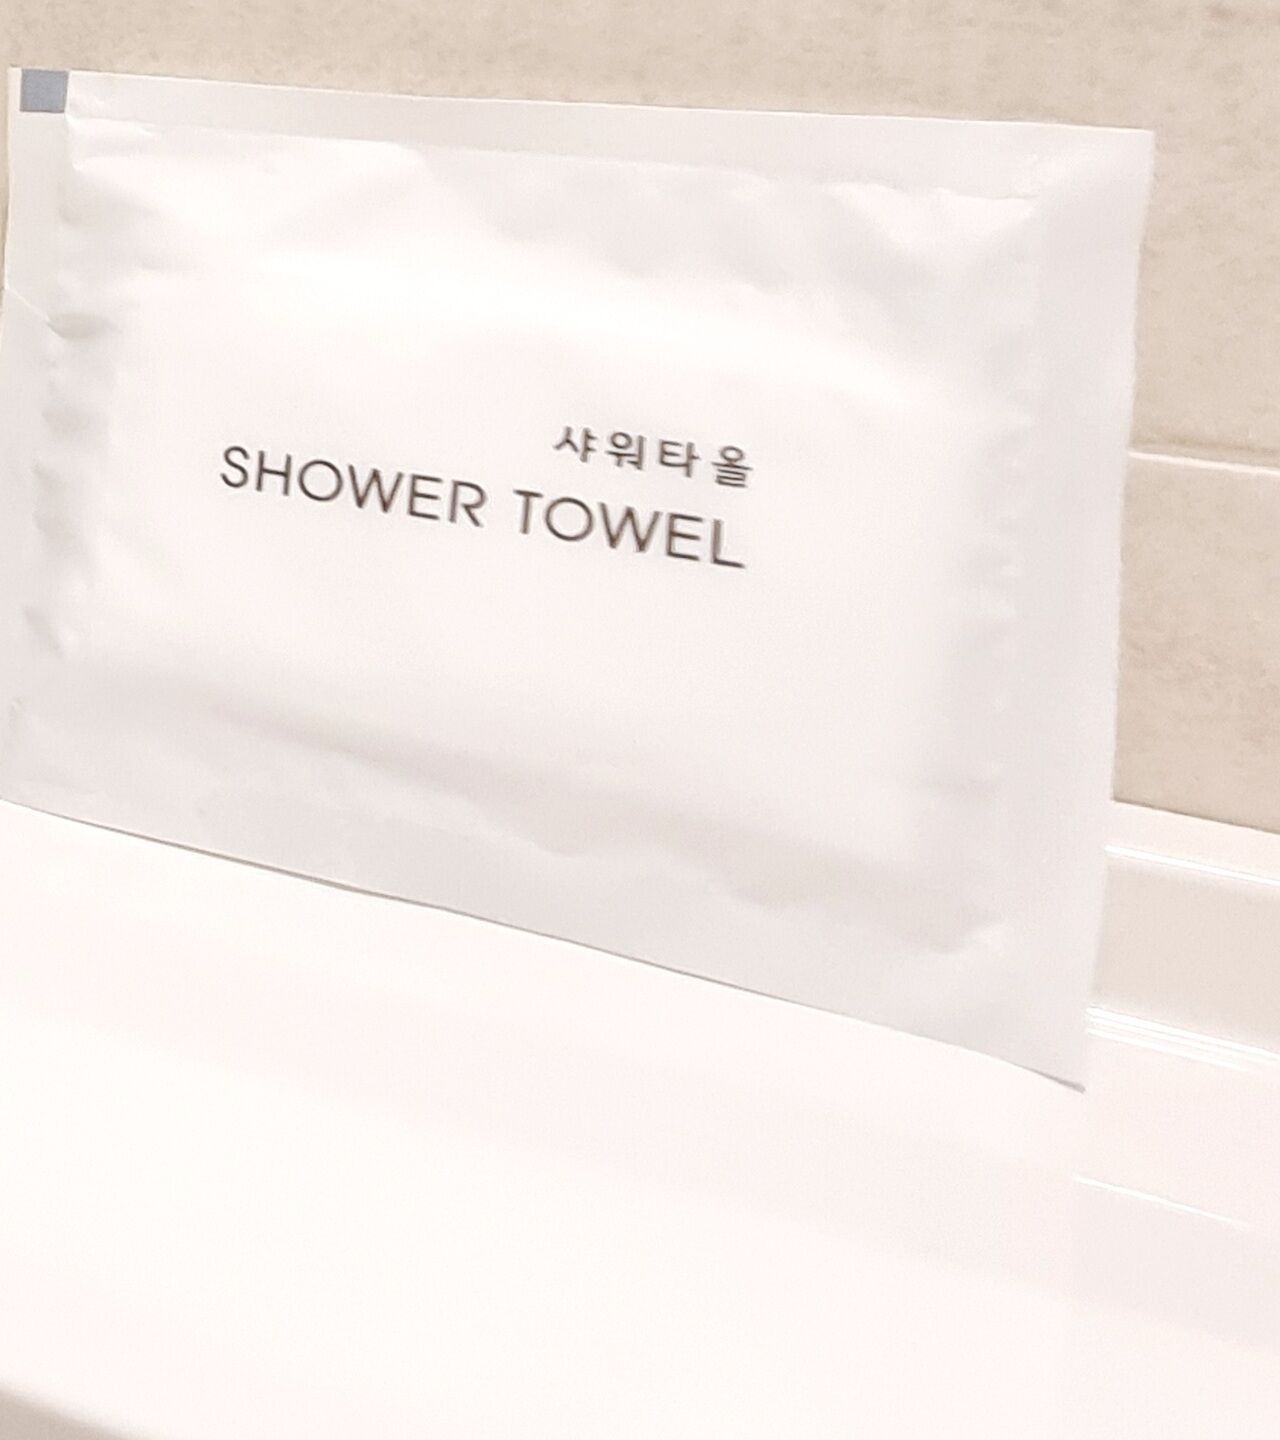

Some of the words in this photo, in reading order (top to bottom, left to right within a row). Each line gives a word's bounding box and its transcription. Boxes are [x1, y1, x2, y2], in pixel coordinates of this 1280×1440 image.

[553, 425, 753, 489] 샤워타올
[220, 445, 487, 528] SHOWER
[513, 489, 746, 570] TOWEL
